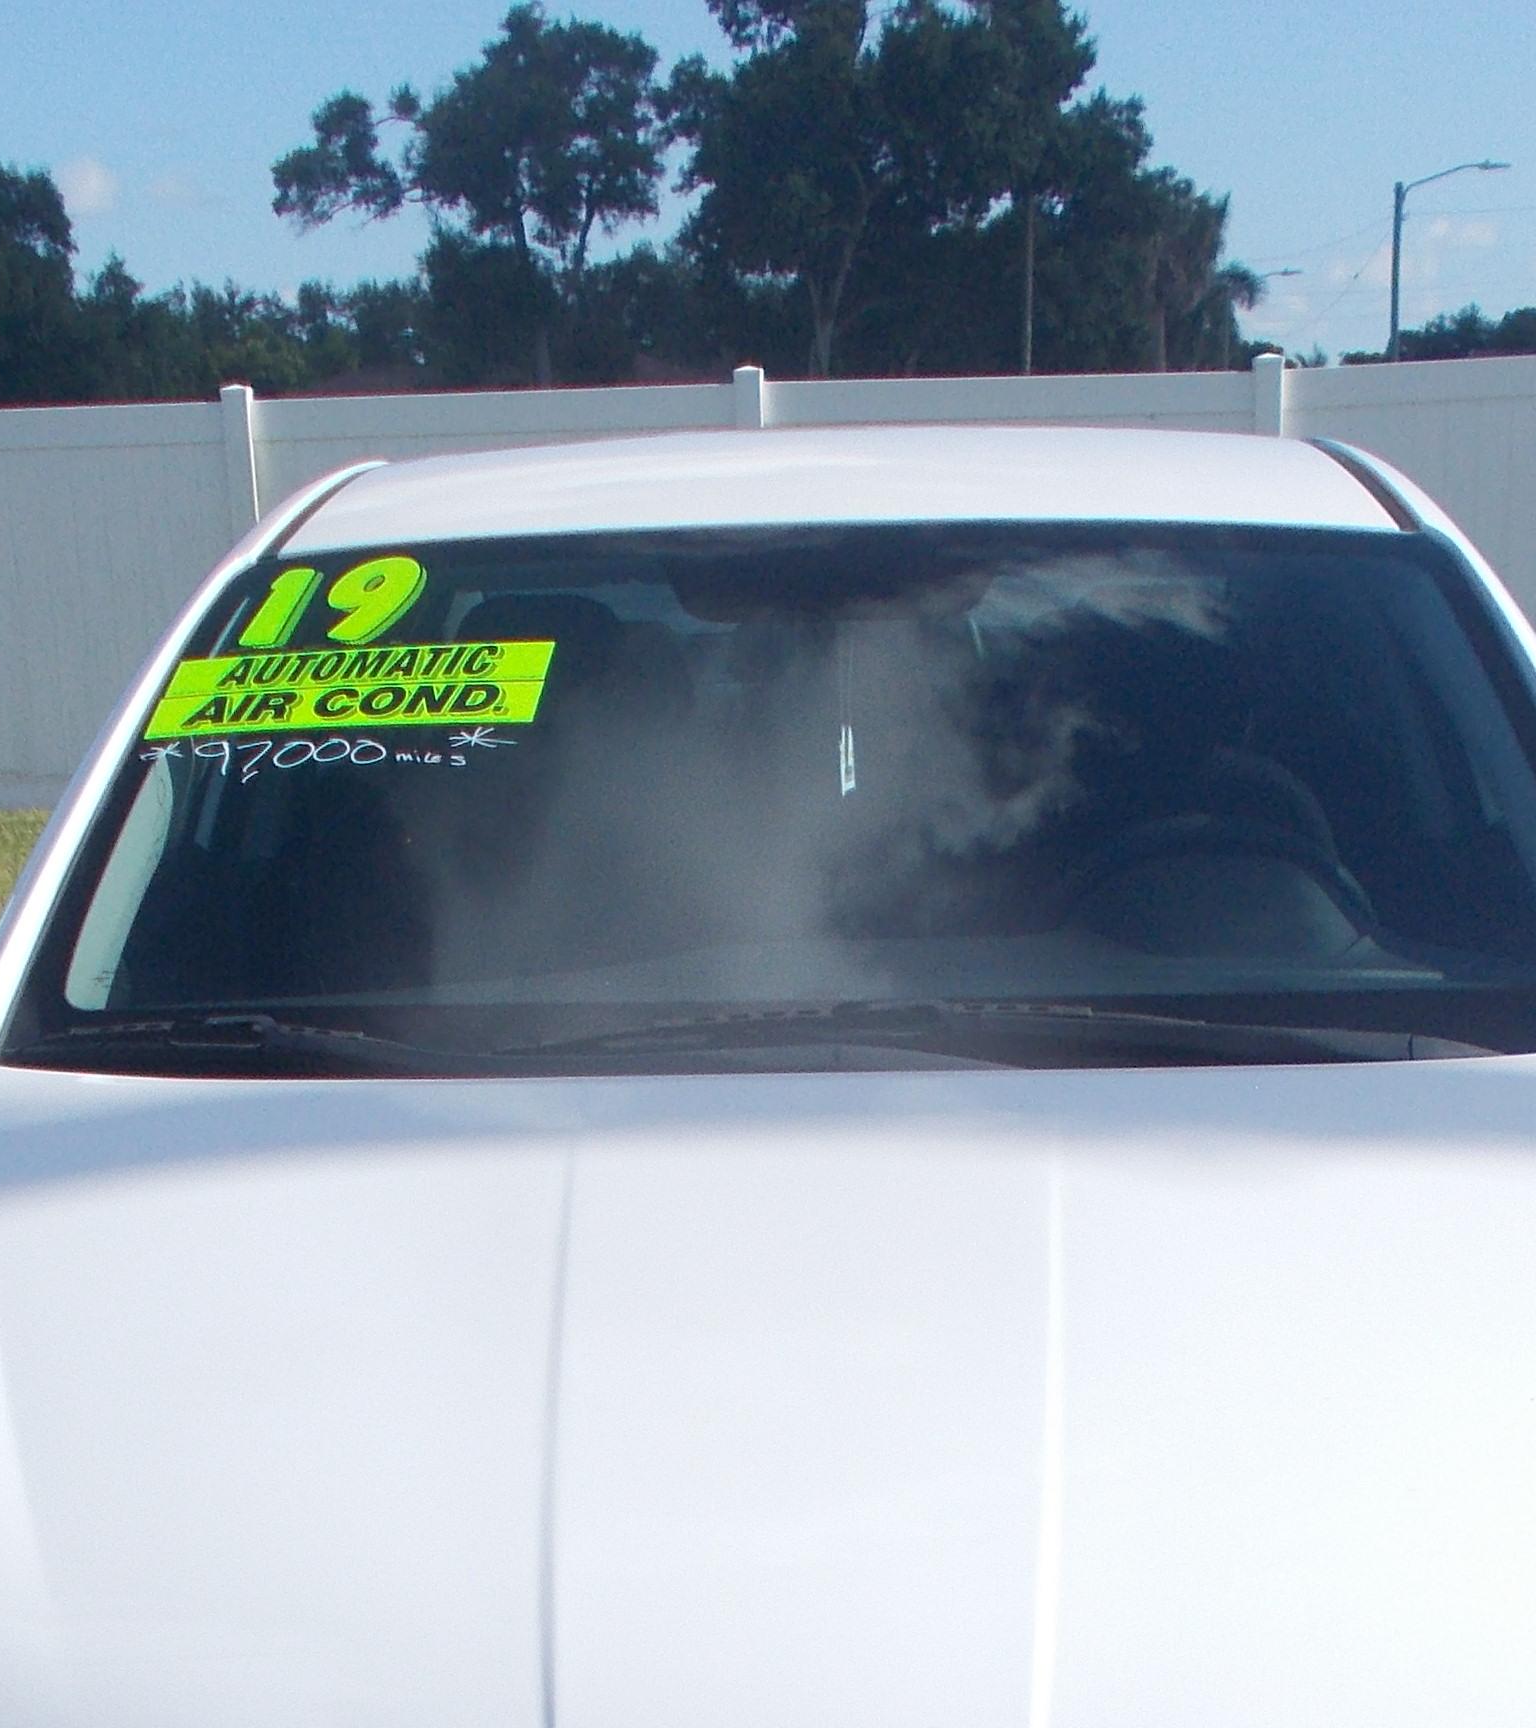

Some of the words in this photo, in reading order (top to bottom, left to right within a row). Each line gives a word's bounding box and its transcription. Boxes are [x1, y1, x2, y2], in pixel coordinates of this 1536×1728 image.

[238, 556, 428, 648] 19
[219, 645, 505, 690] AUTOMATIC
[182, 694, 304, 728] AIR
[312, 683, 507, 720] COND.
